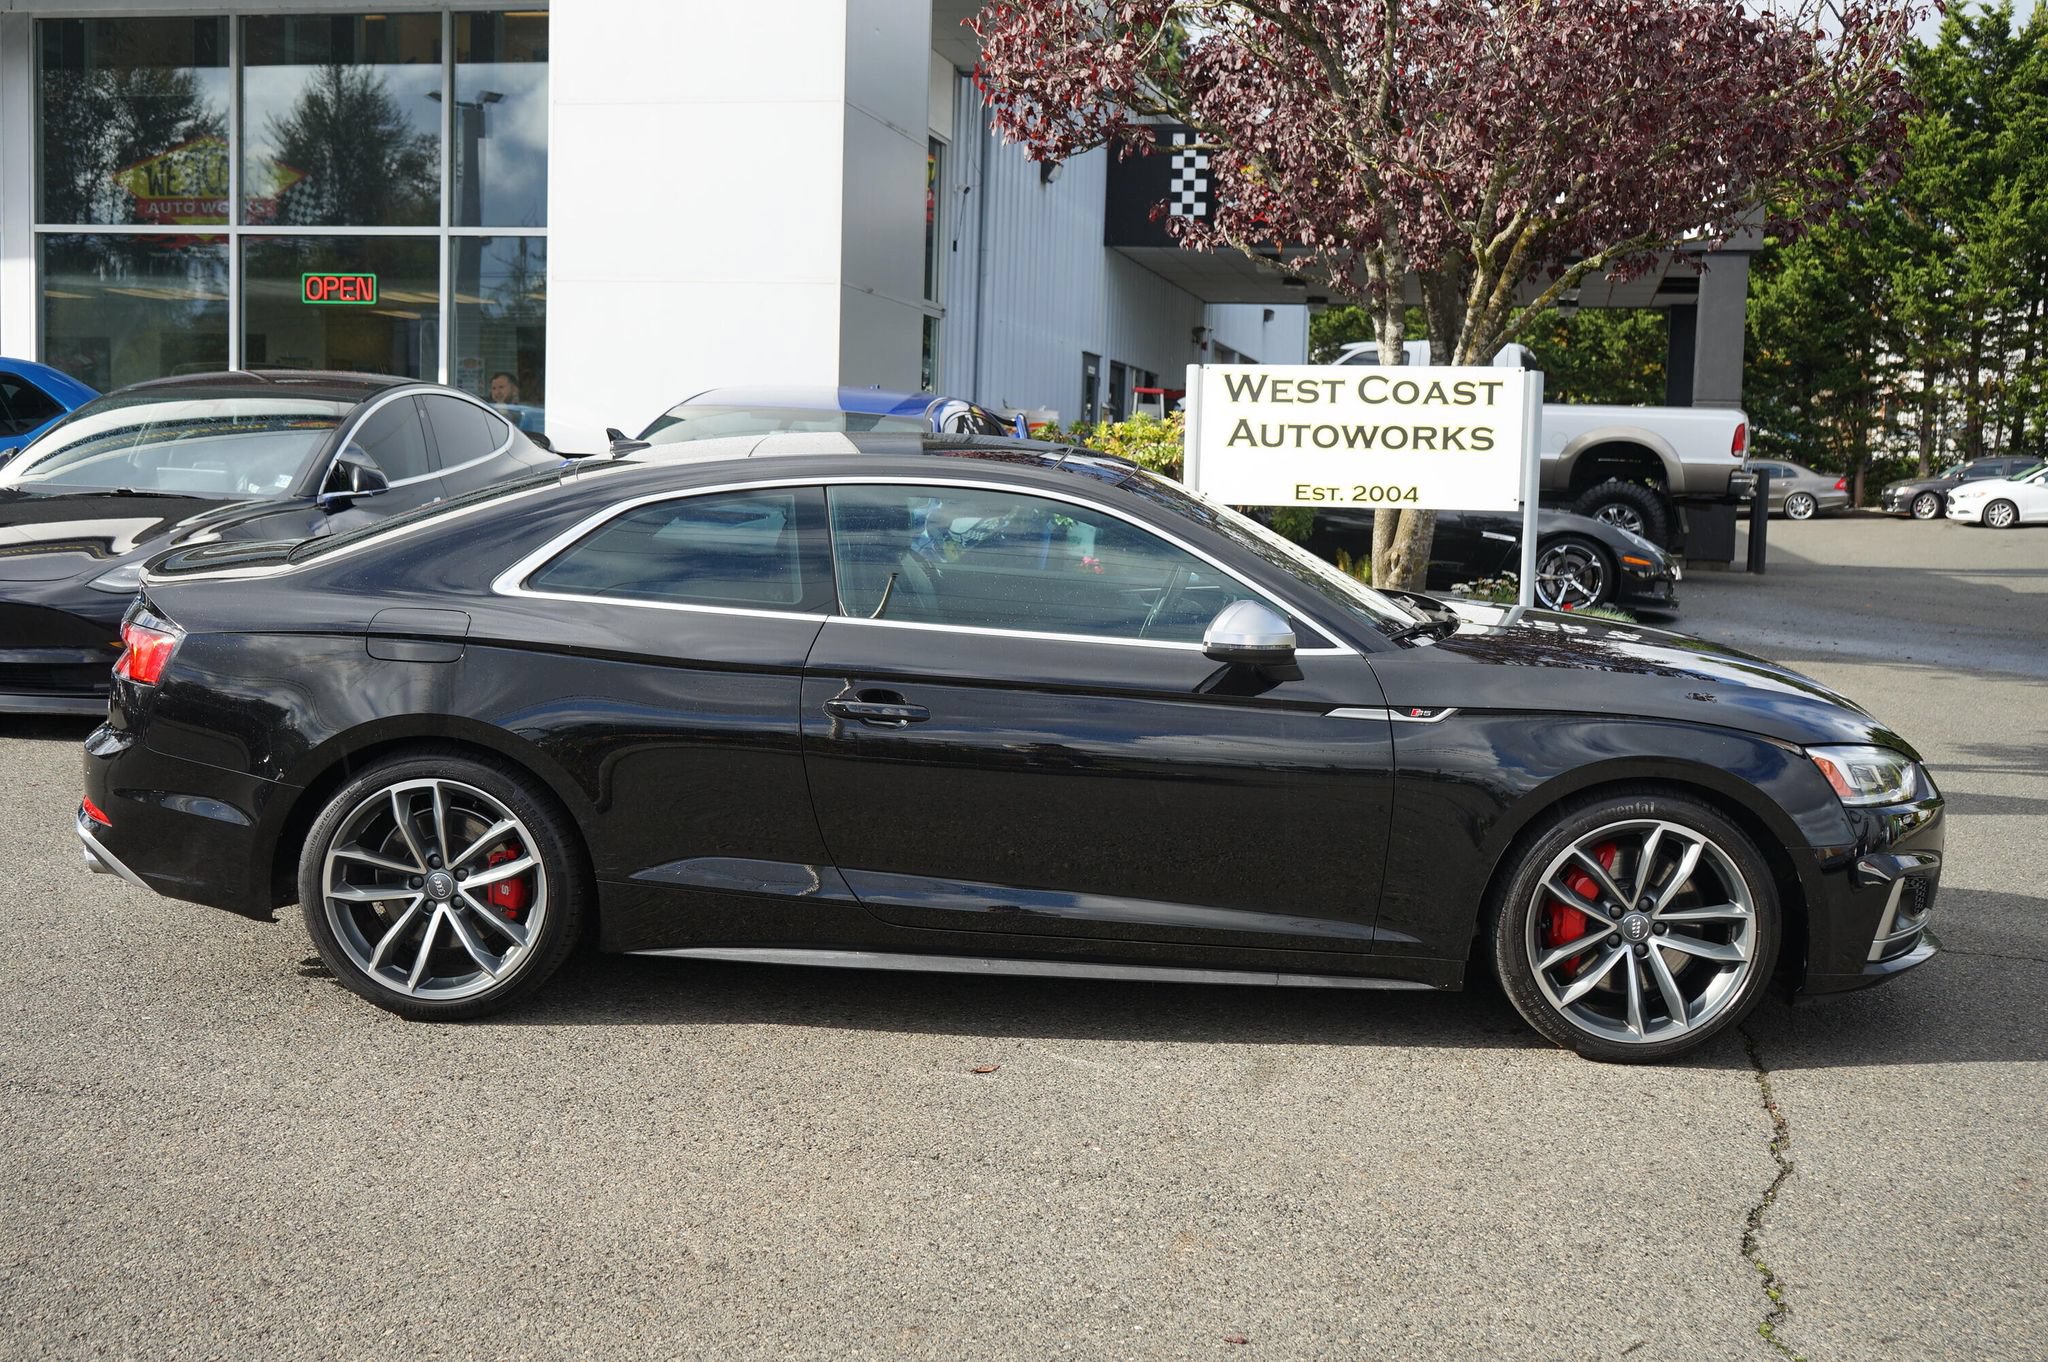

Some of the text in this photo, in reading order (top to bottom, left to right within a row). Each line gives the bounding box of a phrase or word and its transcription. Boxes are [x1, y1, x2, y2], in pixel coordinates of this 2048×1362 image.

[147, 202, 265, 214] AUTO WOKS
[306, 276, 372, 301] OPEN
[1224, 374, 1504, 406] WEST COAST
[1227, 418, 1495, 451] AUTOWORKS
[1295, 484, 1419, 503] EST. 2004
